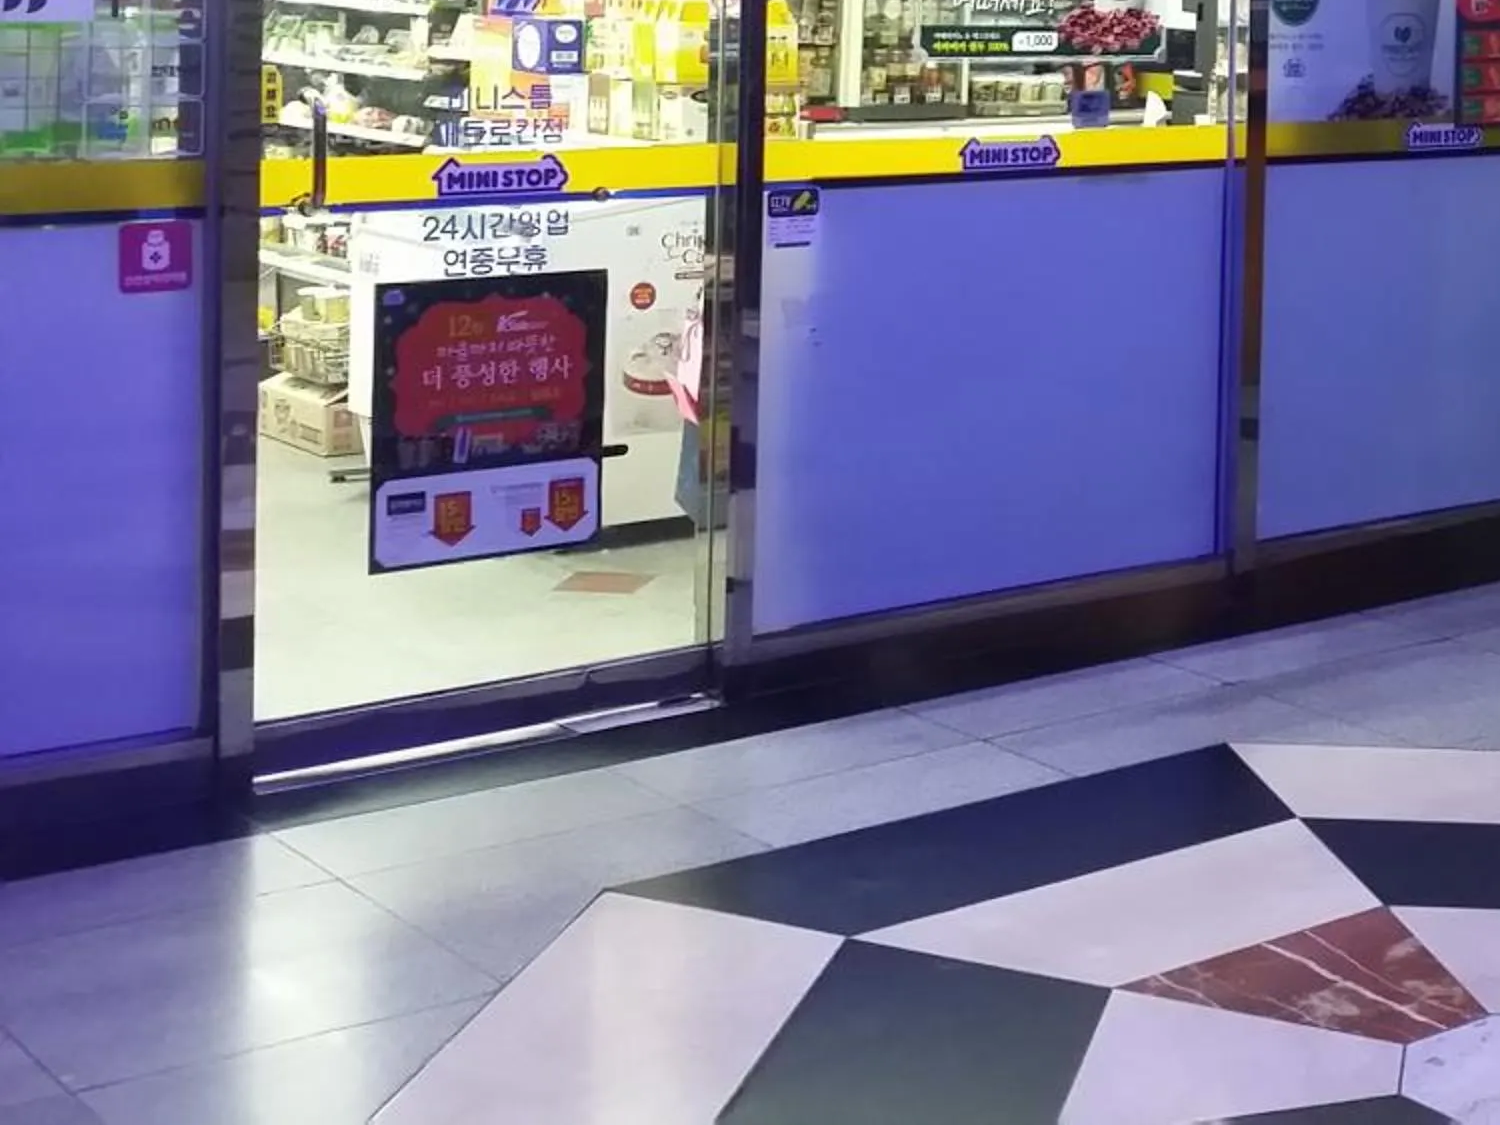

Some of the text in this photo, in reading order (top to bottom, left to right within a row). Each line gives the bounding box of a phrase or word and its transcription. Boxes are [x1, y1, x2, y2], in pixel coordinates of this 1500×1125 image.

[443, 244, 548, 278] 연중무휴
[422, 353, 573, 391] 더 풍성한 행사
